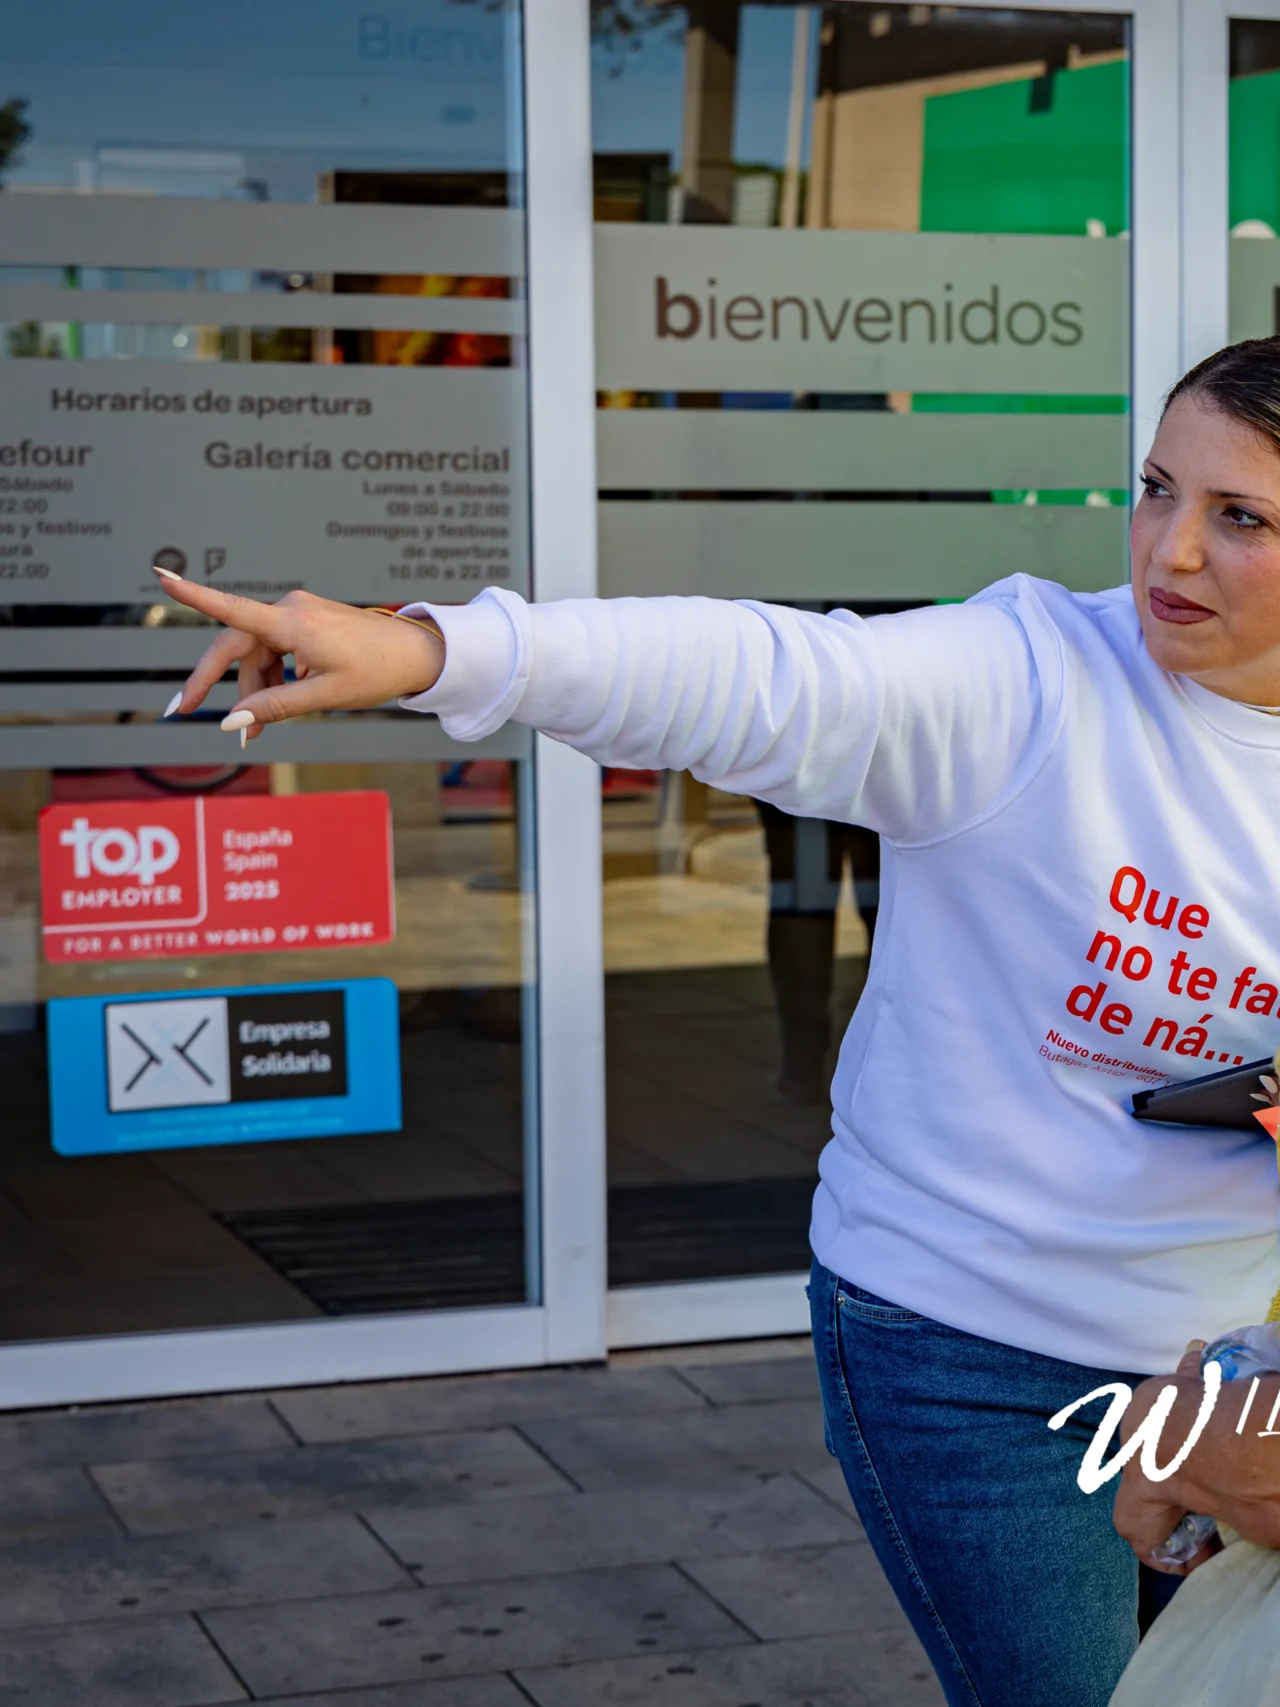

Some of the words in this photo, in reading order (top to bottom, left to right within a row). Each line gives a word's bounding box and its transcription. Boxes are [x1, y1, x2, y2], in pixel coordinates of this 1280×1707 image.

[654, 276, 1083, 348] bienvenidos
[51, 387, 187, 413] Horarios
[193, 389, 231, 414] de
[238, 391, 372, 420] apertura
[205, 441, 331, 470] Galería
[341, 447, 510, 474] comercial
[36, 519, 113, 536] festivos
[326, 521, 419, 541] Domingos
[60, 818, 180, 885] top
[223, 828, 292, 851] España
[223, 851, 277, 874] Spain
[62, 885, 182, 910] EMPLOYER
[225, 880, 279, 902] 2025
[1109, 866, 1210, 939] Que
[64, 937, 103, 954] FOR
[109, 936, 123, 951] A
[130, 932, 199, 951] BETTER
[205, 926, 276, 946] WORLD
[282, 925, 309, 942] OF
[315, 922, 374, 941] WORK
[1085, 930, 1153, 982] no
[1168, 949, 1218, 1001] te
[239, 1021, 331, 1046] Empresa
[1066, 981, 1133, 1035] de
[1143, 1014, 1244, 1065] ná...
[241, 1051, 332, 1077] Solidaria
[1046, 1029, 1089, 1058] Nuevo
[1092, 1053, 1171, 1078] distribuidor
